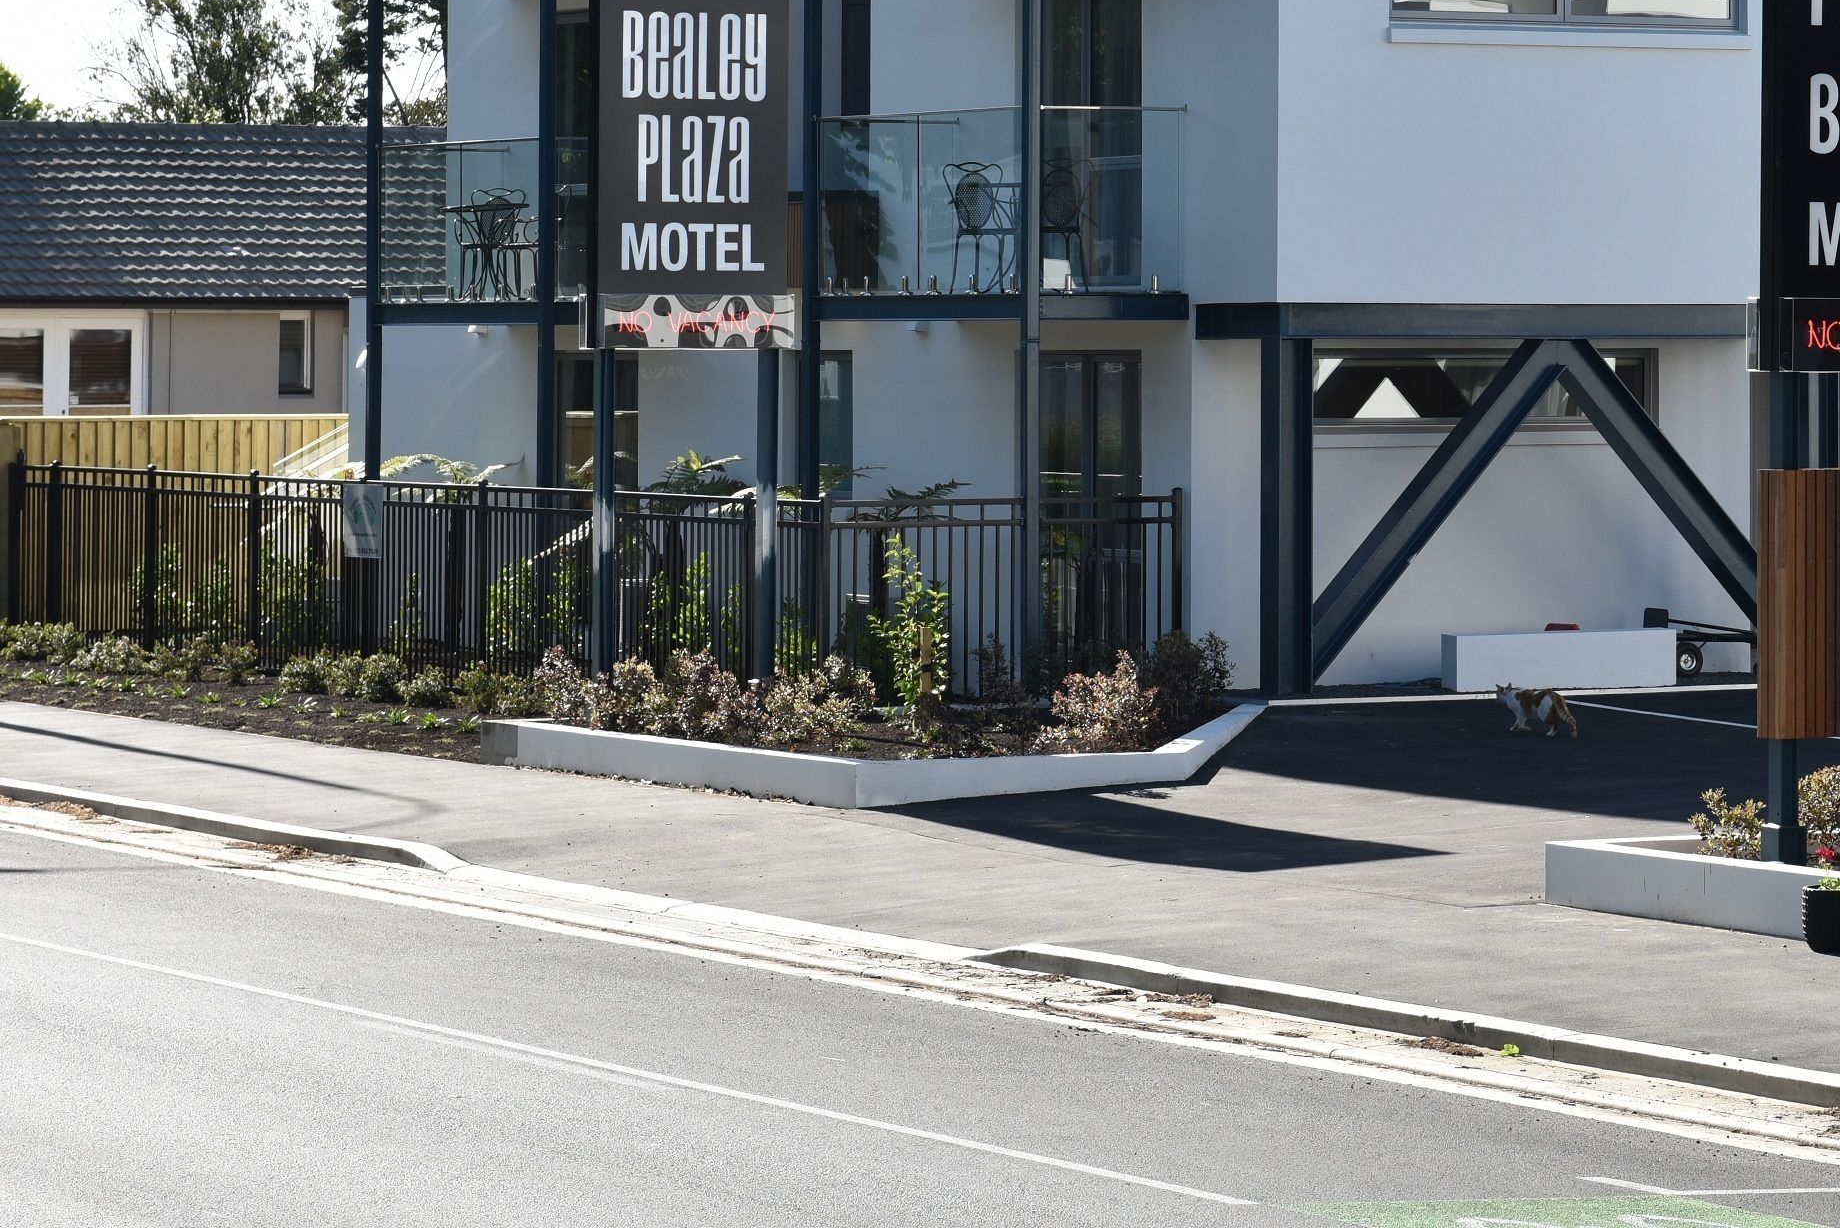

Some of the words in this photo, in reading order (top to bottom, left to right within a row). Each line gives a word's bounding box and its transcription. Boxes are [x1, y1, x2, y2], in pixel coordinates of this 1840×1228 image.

[620, 222, 766, 272] MOTEL
[618, 310, 653, 333] NO
[667, 310, 775, 334] VACANCY
